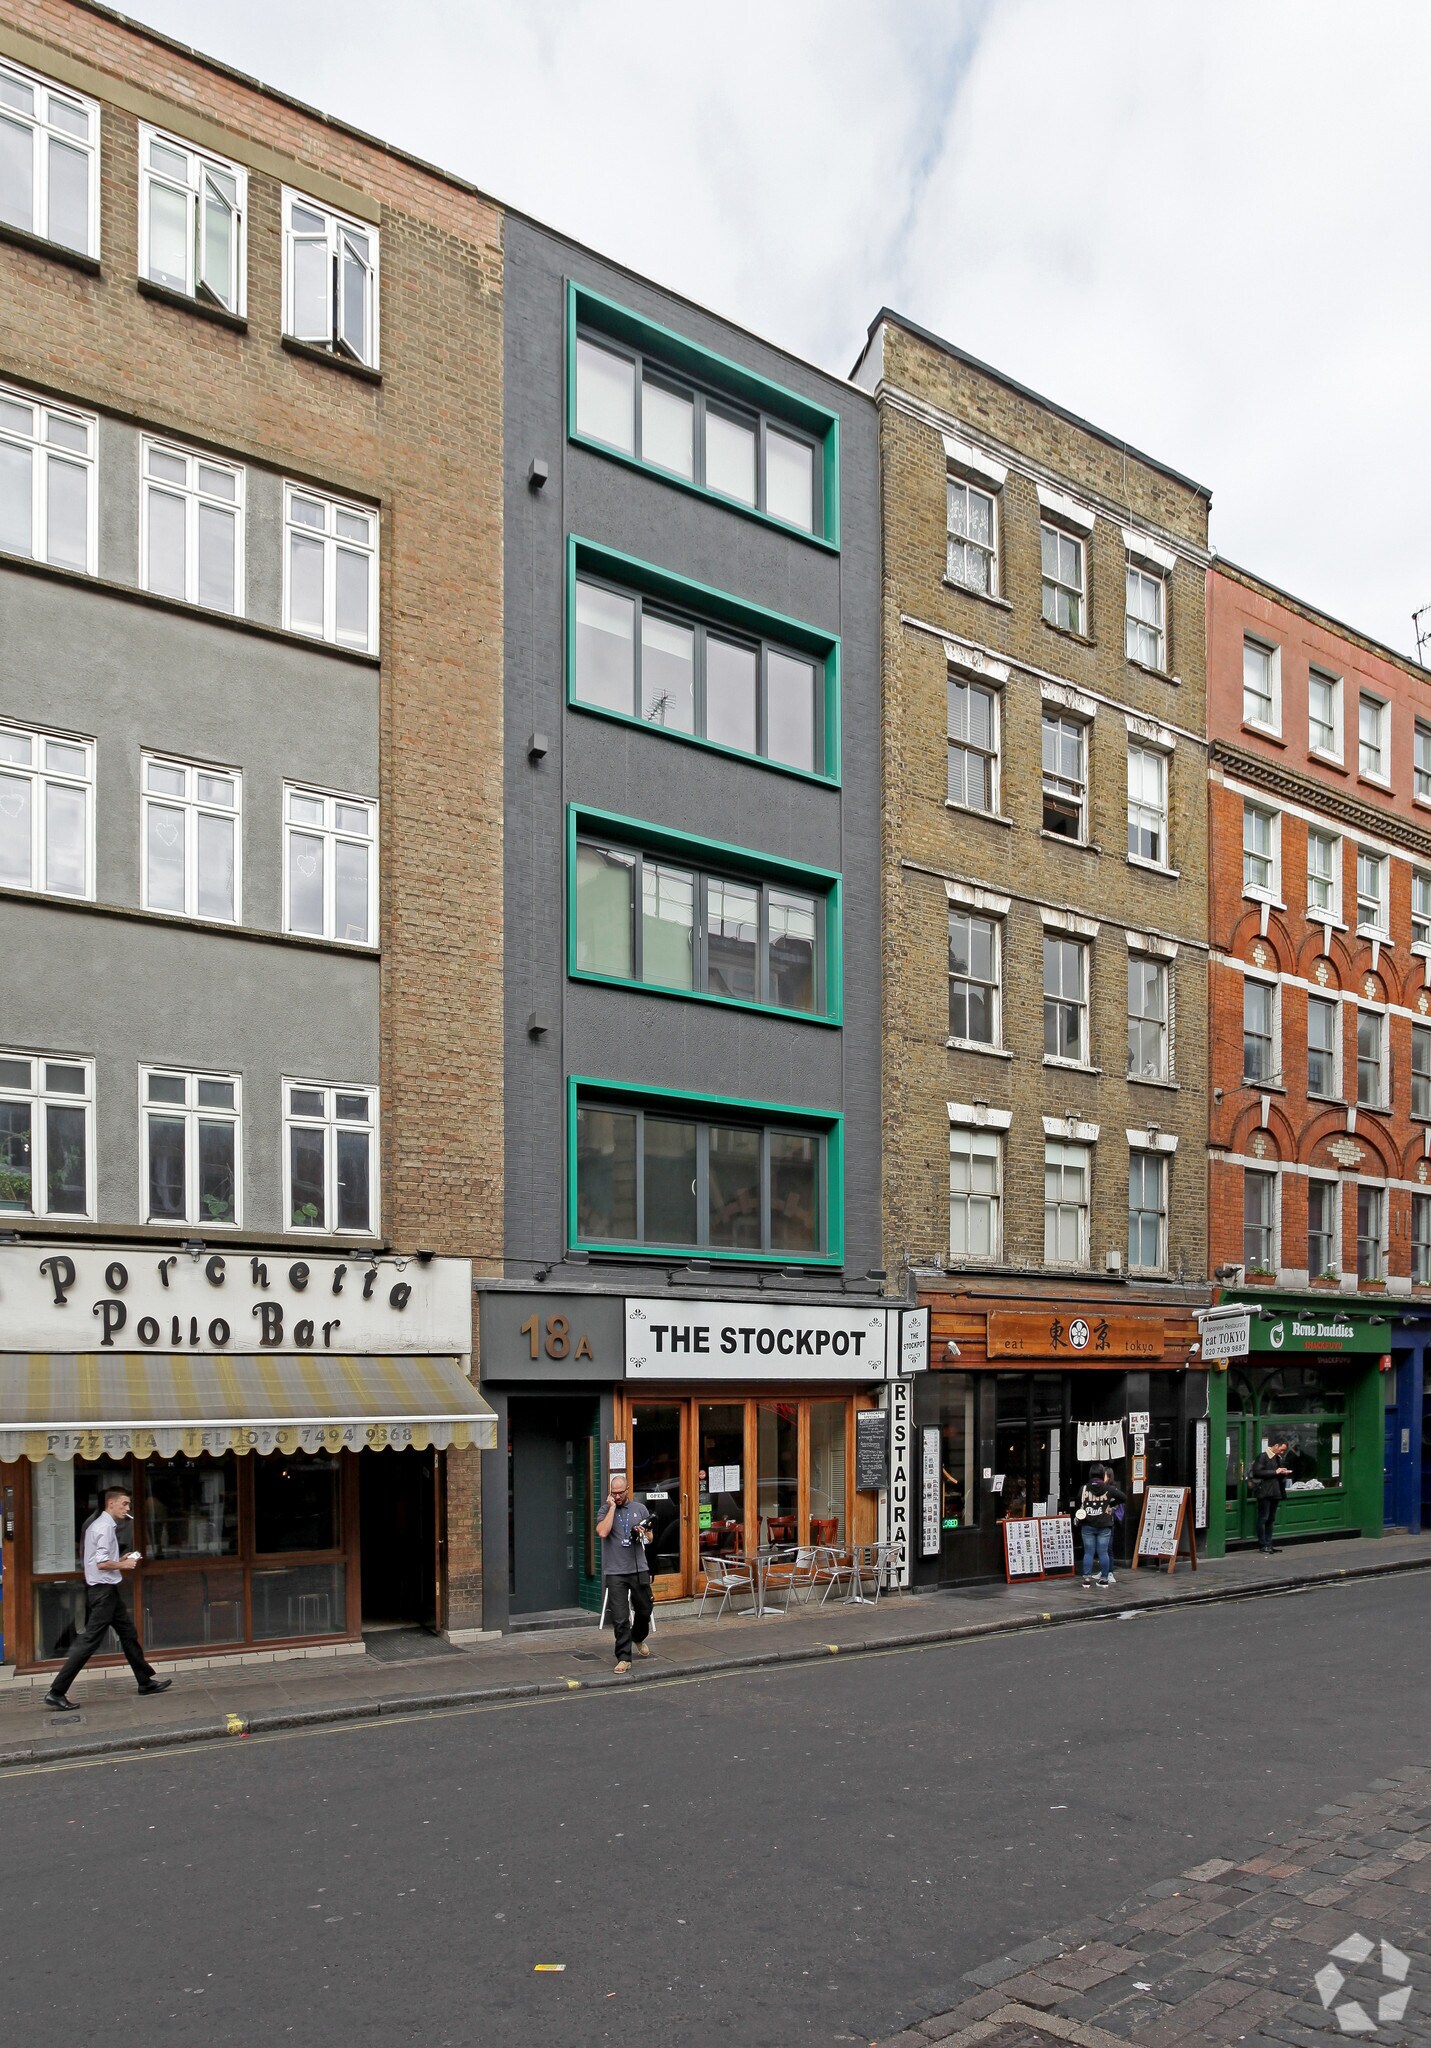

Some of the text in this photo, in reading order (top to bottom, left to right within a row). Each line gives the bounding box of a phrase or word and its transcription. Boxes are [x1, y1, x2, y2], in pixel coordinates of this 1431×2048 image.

[39, 1255, 412, 1310] Porchetta
[92, 1298, 341, 1348] Pollo Bar
[1224, 1321, 1246, 1330] Restaurant
[1292, 1321, 1355, 1338] Bone Daddies
[650, 1325, 867, 1357] THE STOCKPOT
[910, 1332, 919, 1340] THE
[1048, 1318, 1112, 1351] 東 京
[1205, 1330, 1246, 1346] eat TOKYO
[903, 1340, 925, 1351] STOCKPOT
[1004, 1339, 1154, 1354] eat tokyo
[1205, 1348, 1216, 1356] 020
[1216, 1346, 1231, 1354] 7439
[47, 1426, 413, 1452] PIZZERIA TEL. 020 7494 9368
[893, 1384, 907, 1583] RESTAURANT
